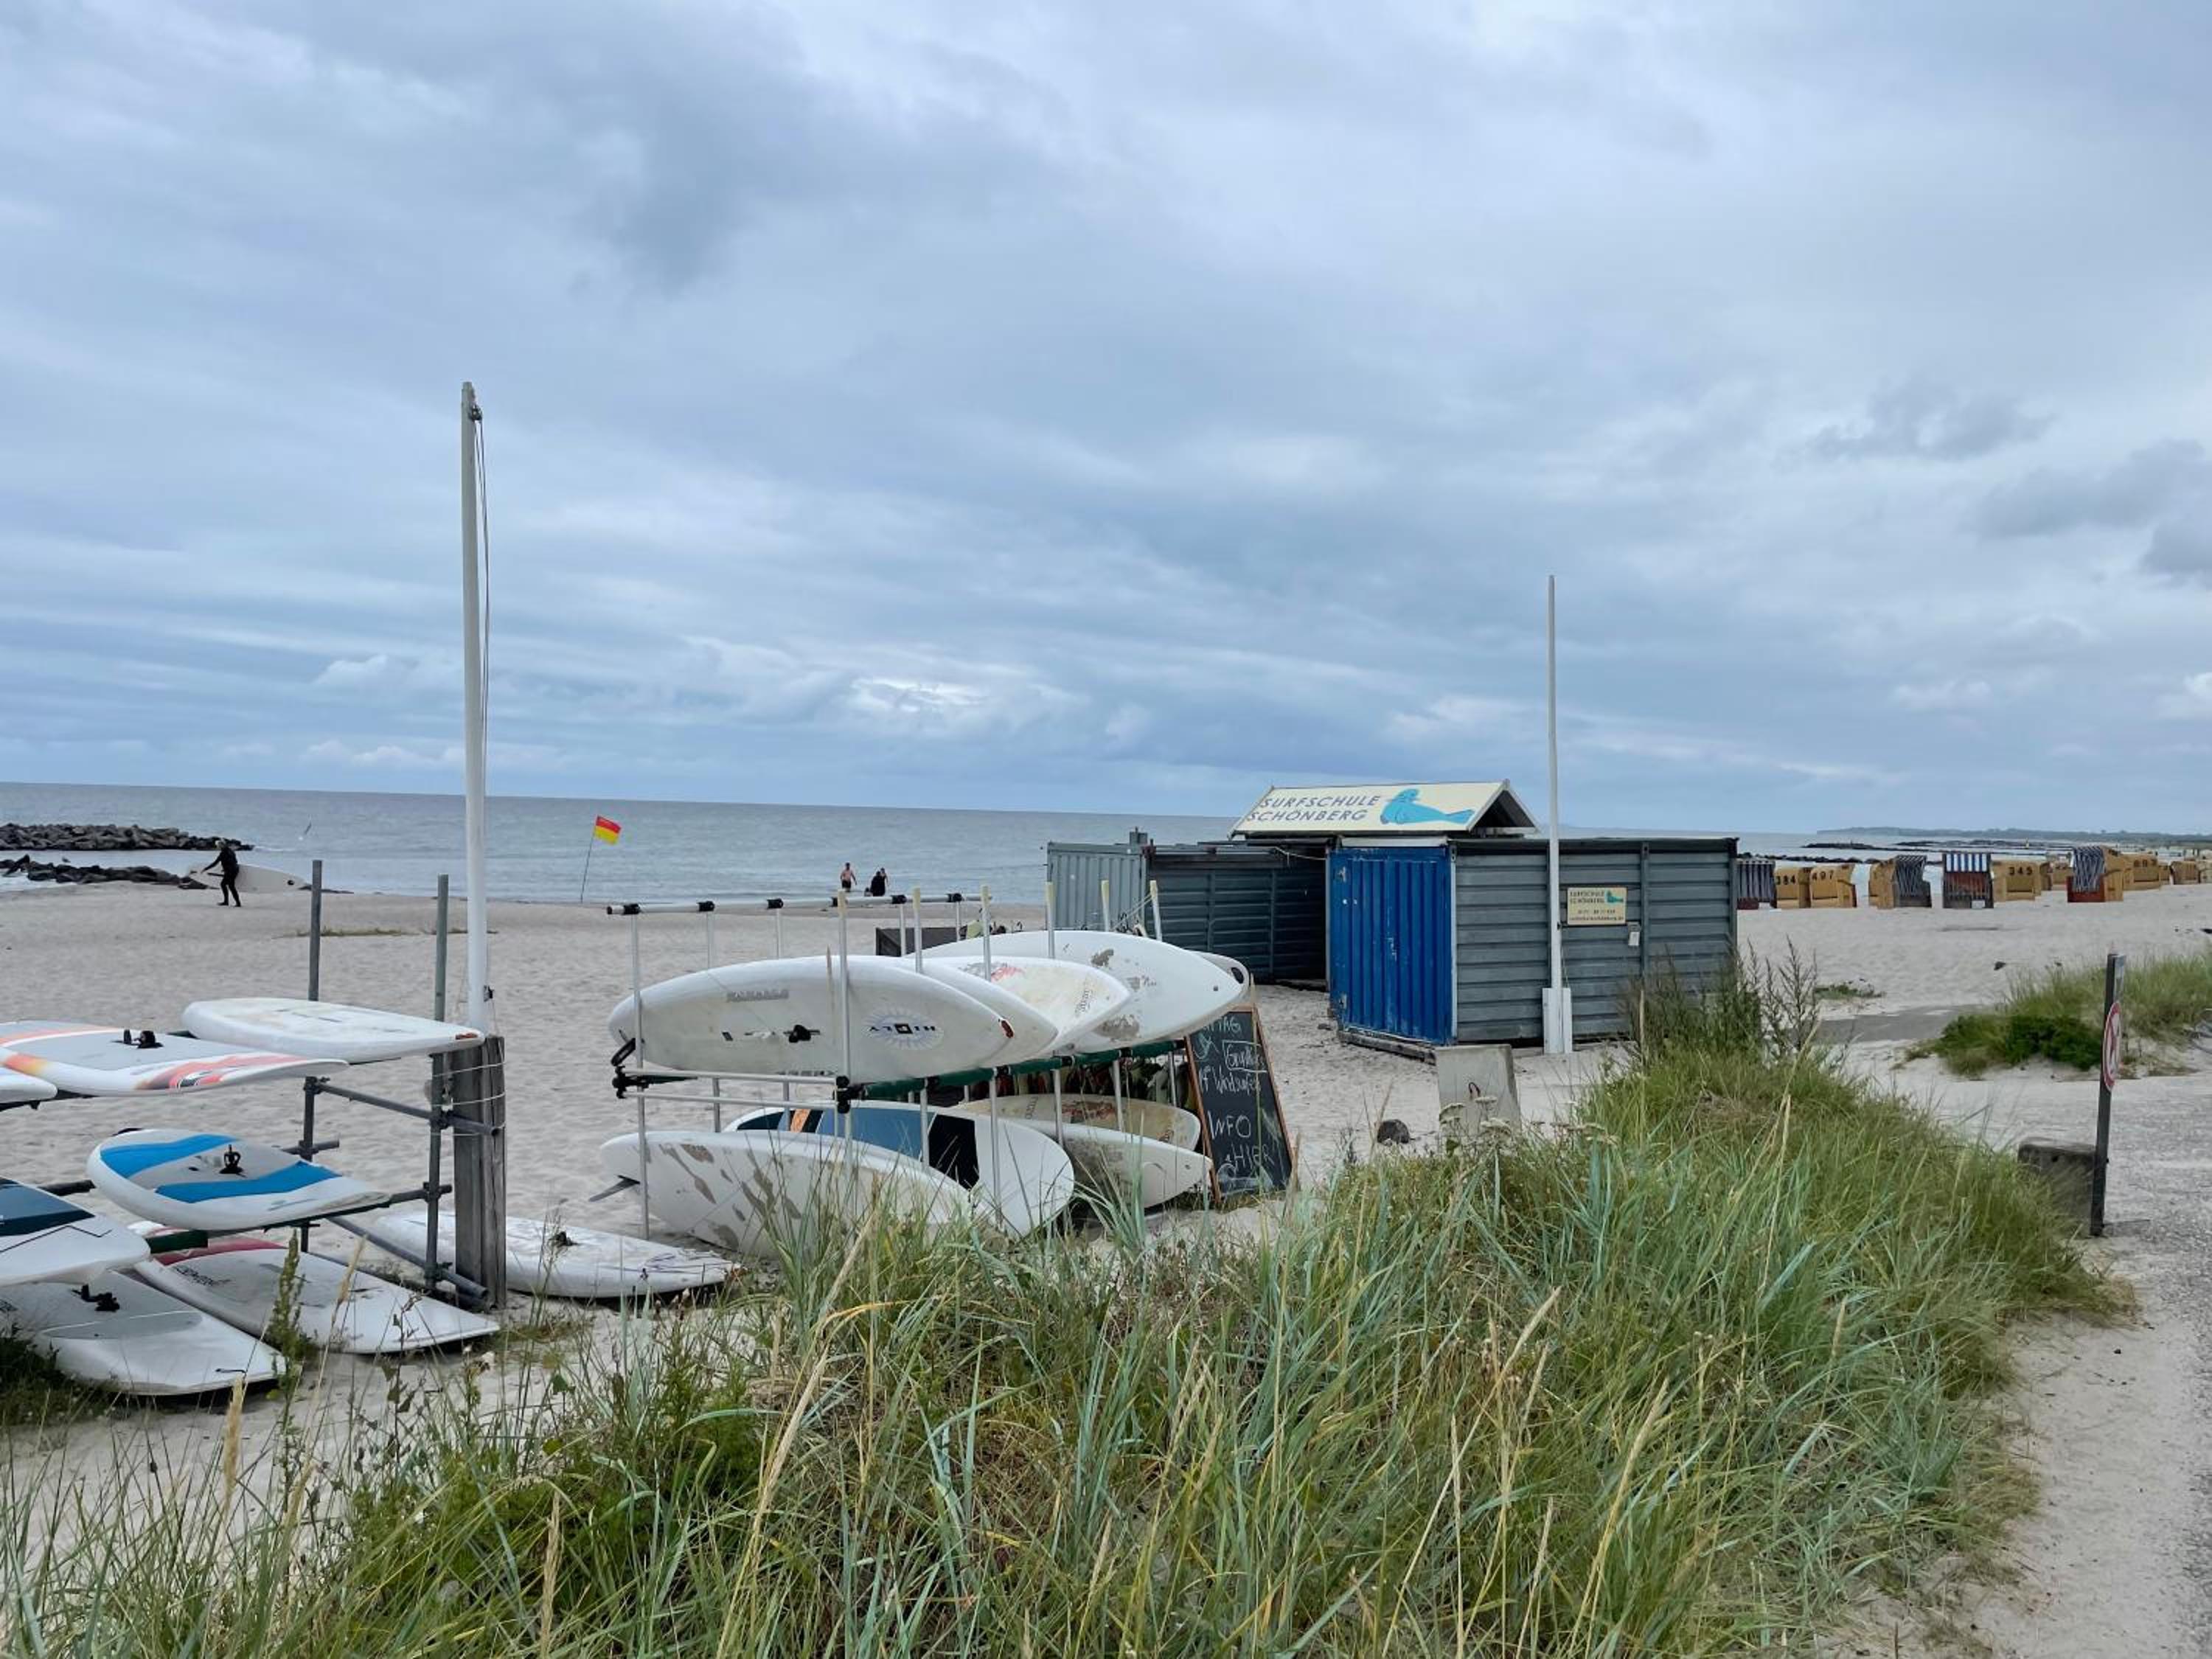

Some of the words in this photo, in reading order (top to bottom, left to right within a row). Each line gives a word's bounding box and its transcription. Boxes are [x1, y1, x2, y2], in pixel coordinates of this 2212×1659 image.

[1260, 796, 1381, 808] SURFSCHULE
[1247, 809, 1368, 821] SCHÖNBERG
[1207, 1110, 1251, 1140] INFO
